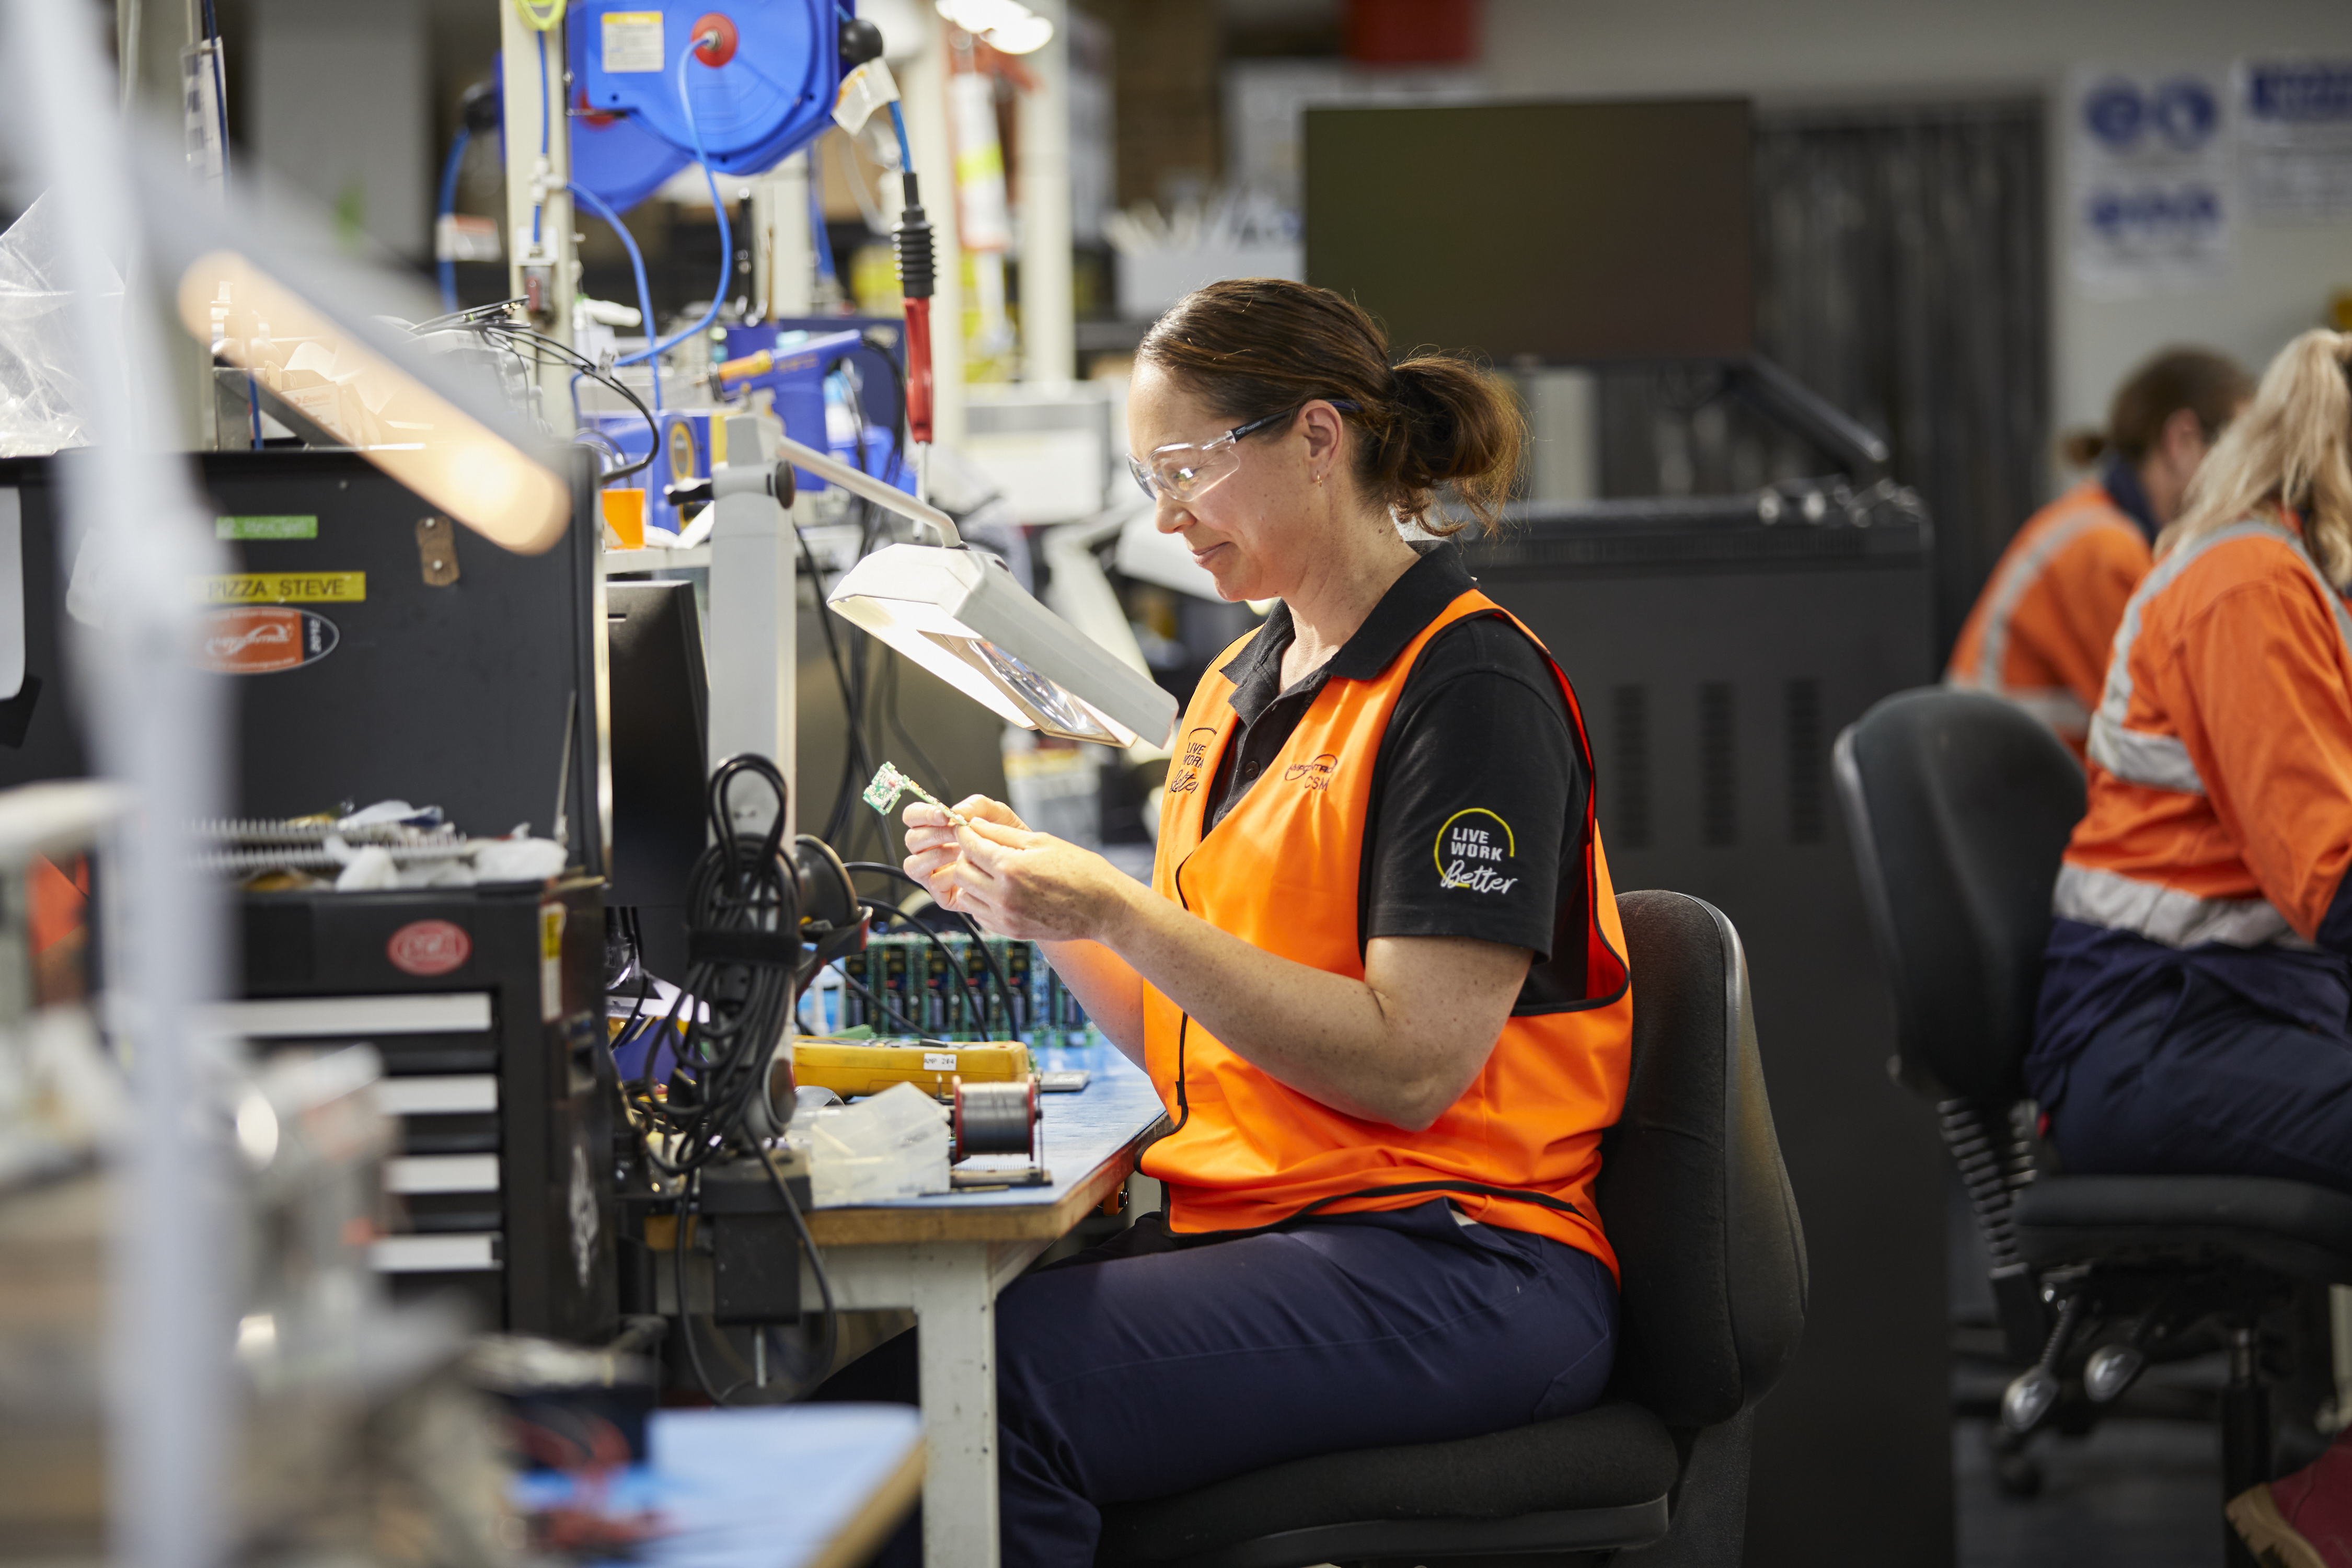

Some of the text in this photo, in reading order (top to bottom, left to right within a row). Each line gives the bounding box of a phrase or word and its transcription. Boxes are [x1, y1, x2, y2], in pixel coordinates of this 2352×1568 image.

[209, 579, 345, 599] PIZZA STEVE
[1187, 742, 1206, 755] LIVE
[1289, 763, 1334, 774] AMPCONTRO
[1305, 776, 1330, 791] CSM
[1452, 827, 1490, 844] LIVE
[1451, 841, 1503, 861] WORK
[1440, 859, 1518, 894] Better
